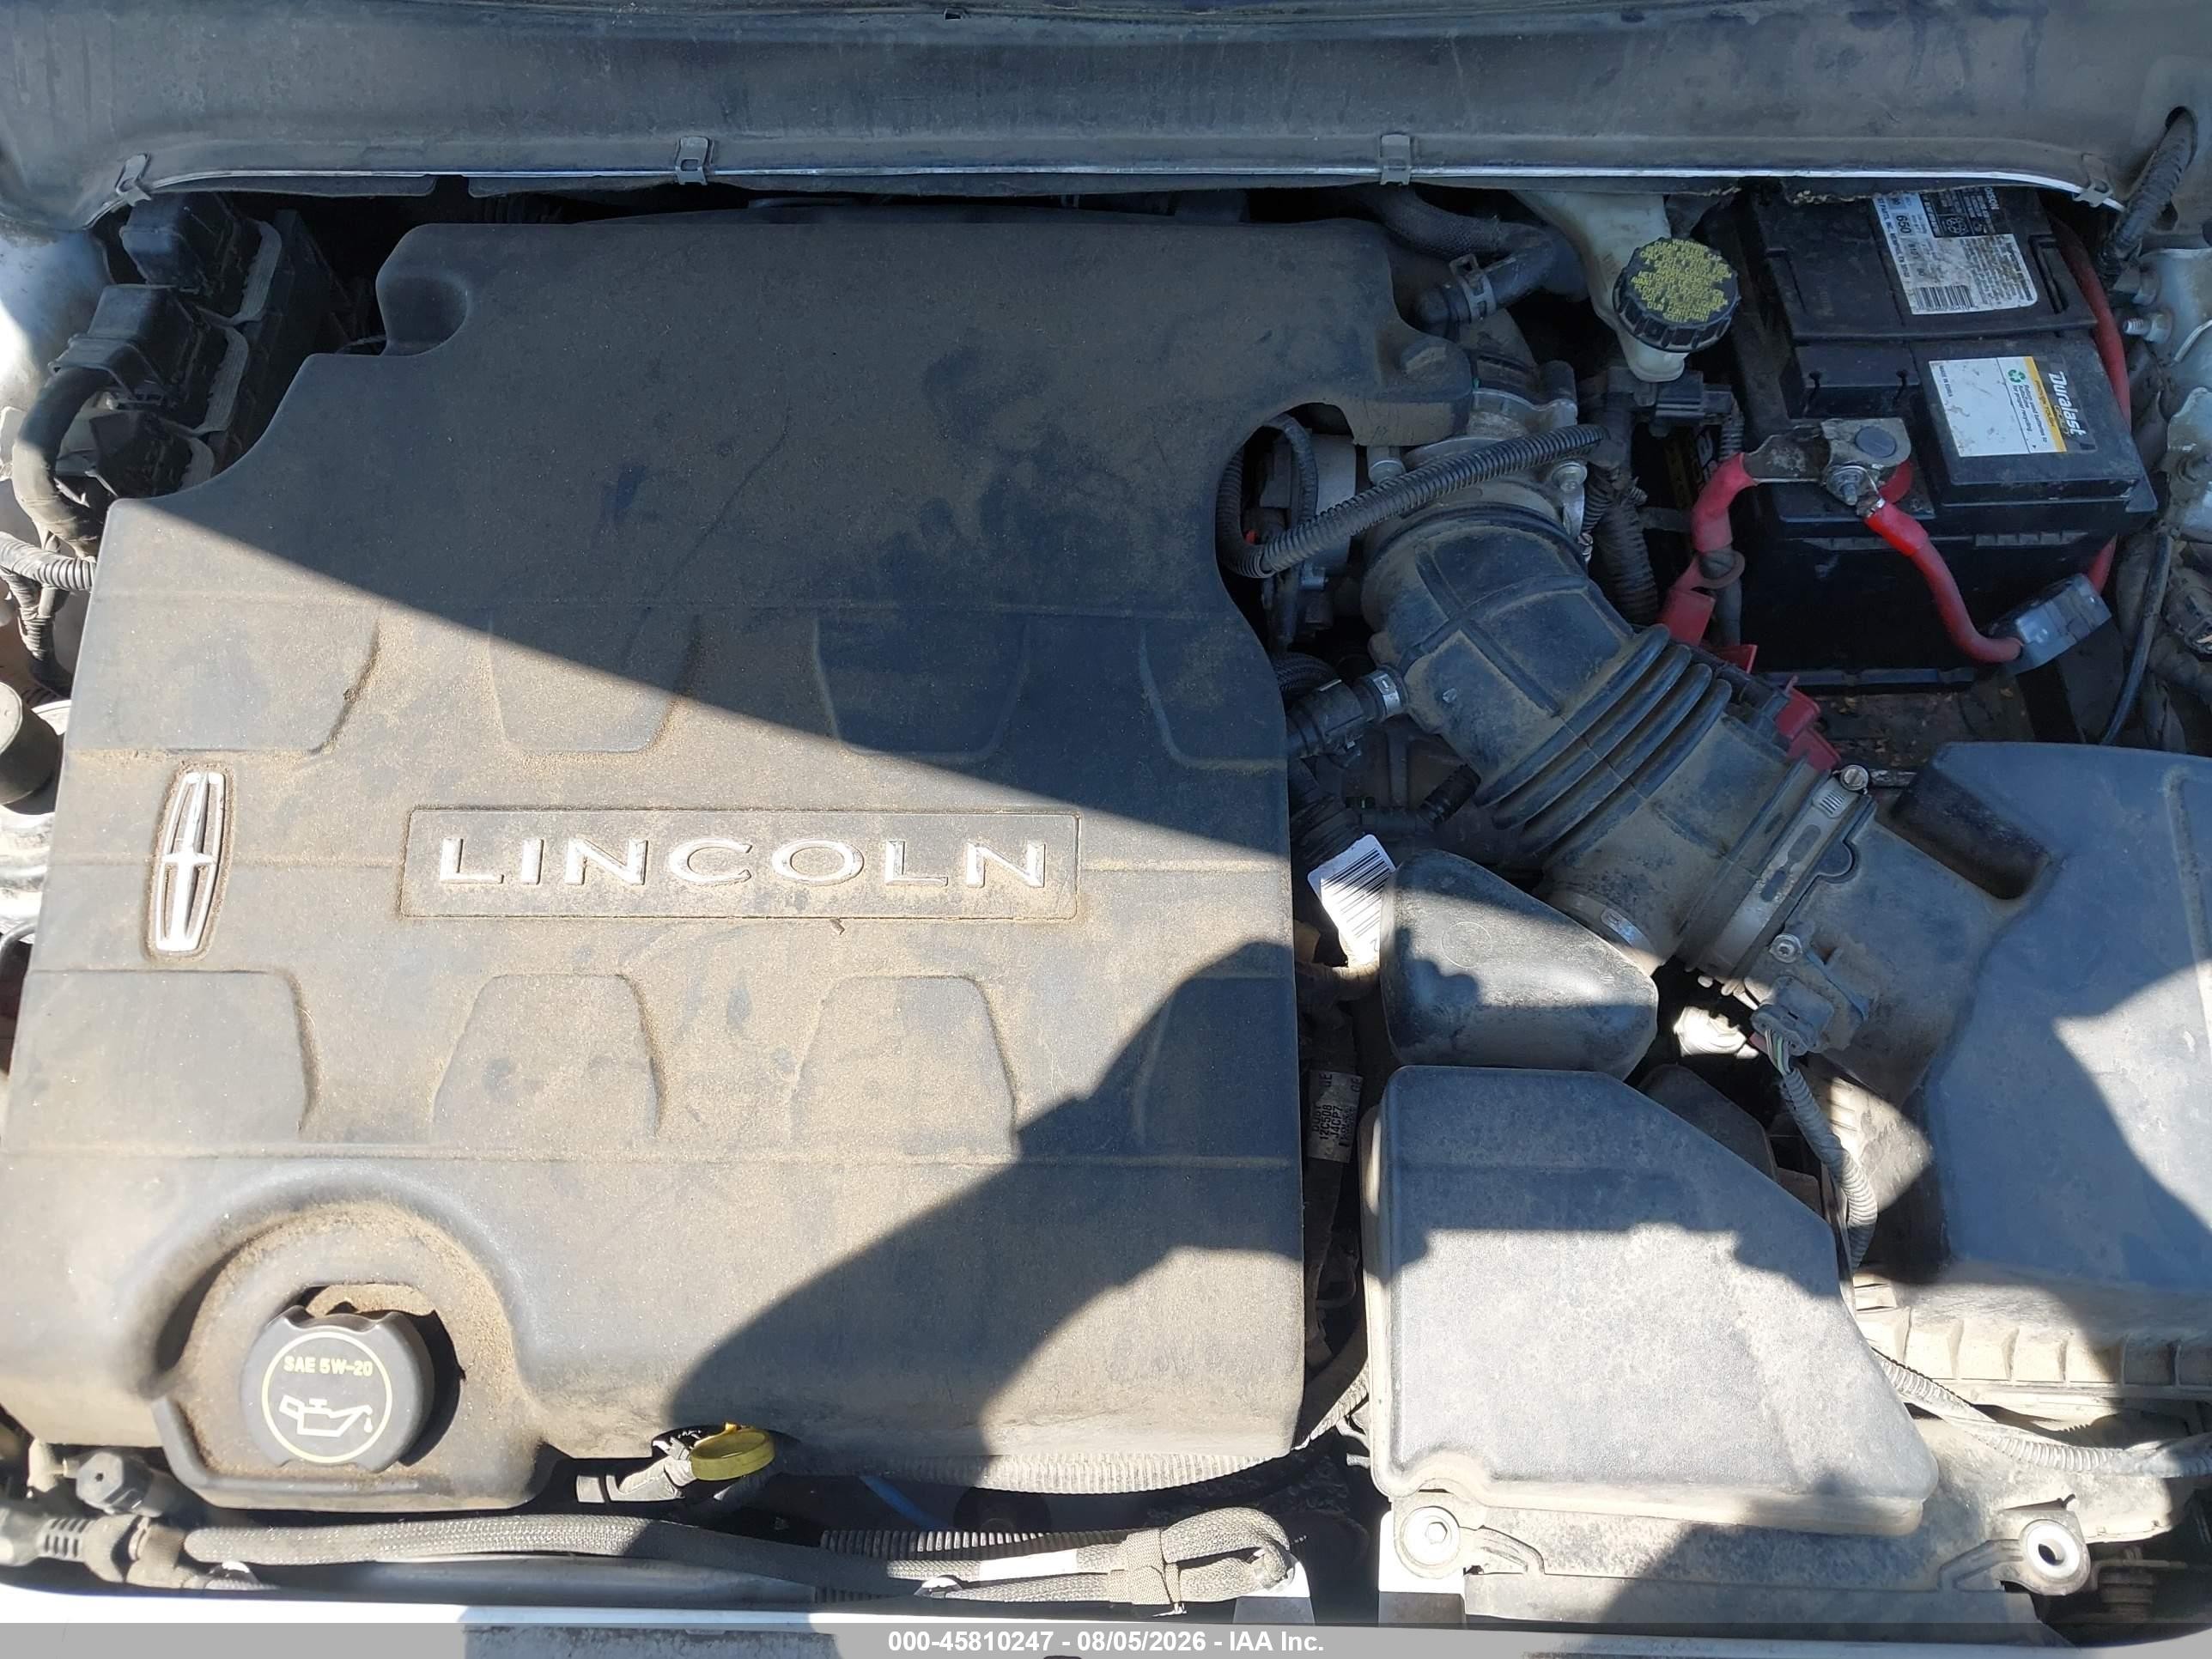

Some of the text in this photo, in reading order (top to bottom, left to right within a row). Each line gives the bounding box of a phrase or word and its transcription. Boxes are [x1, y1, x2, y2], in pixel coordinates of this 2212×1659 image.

[1895, 215, 1912, 234] 650
[2049, 371, 2087, 436] Duralast
[439, 837, 1048, 888] LINCOLN
[1318, 1104, 1333, 1140] 12C508
[1329, 1105, 1344, 1139] J4CP7
[283, 1356, 374, 1377] SAE 5W-20
